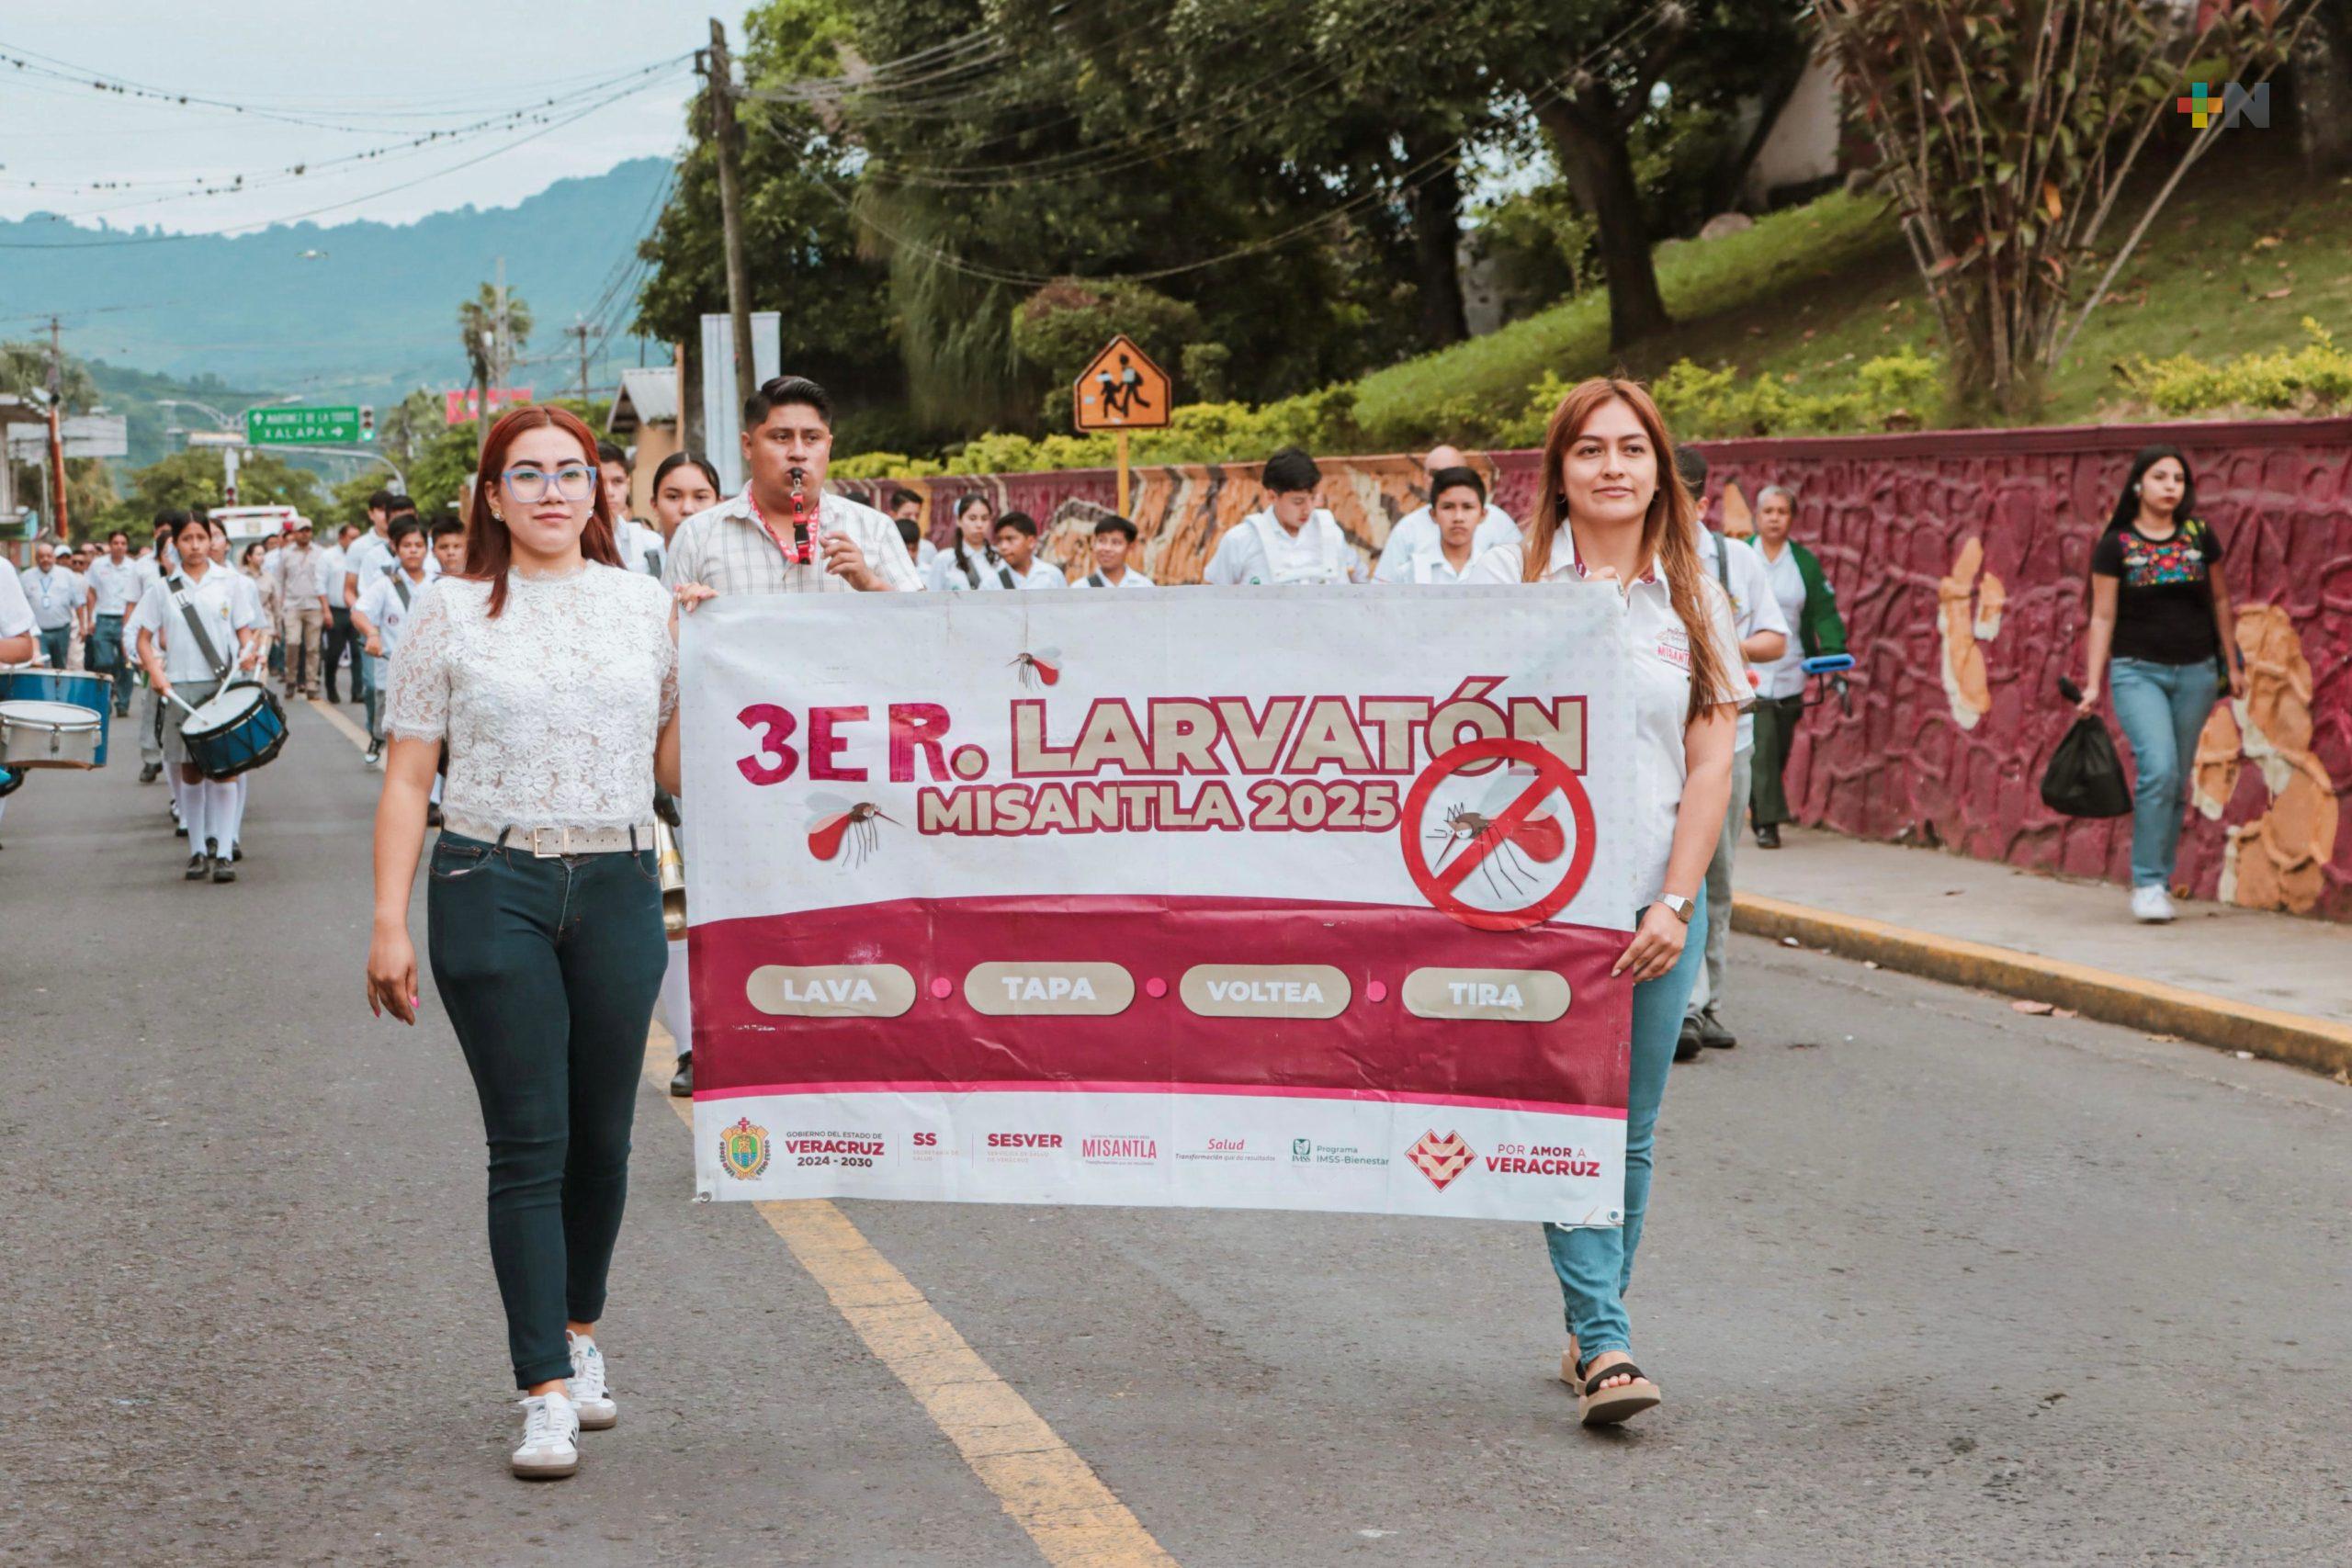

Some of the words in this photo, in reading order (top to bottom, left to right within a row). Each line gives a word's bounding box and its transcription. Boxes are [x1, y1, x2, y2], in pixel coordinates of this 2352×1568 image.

[1011, 675, 1588, 778] LARVATÓN
[917, 780, 1245, 837] MISANTLA
[1247, 778, 1403, 833] 2025
[784, 978, 877, 1002] LAVA
[1001, 976, 1096, 1001] TAPA
[1206, 980, 1324, 1003] VOLTEA
[1448, 982, 1523, 1010] TIRA
[913, 1132, 937, 1145] SS
[988, 1134, 1063, 1147] SESVER
[1208, 1139, 1244, 1150] Salud
[785, 1140, 885, 1156] VERACRUZ
[1082, 1138, 1157, 1159] MISANTLA
[1317, 1145, 1358, 1154] Programa
[1498, 1144, 1525, 1155] POR
[1531, 1146, 1572, 1157] AMOR
[1577, 1148, 1587, 1157] A
[797, 1156, 831, 1167] 2024
[841, 1157, 873, 1168] 2030
[1317, 1155, 1389, 1165] IMSS-Bienestar
[1486, 1156, 1600, 1177] VERACRUZ
